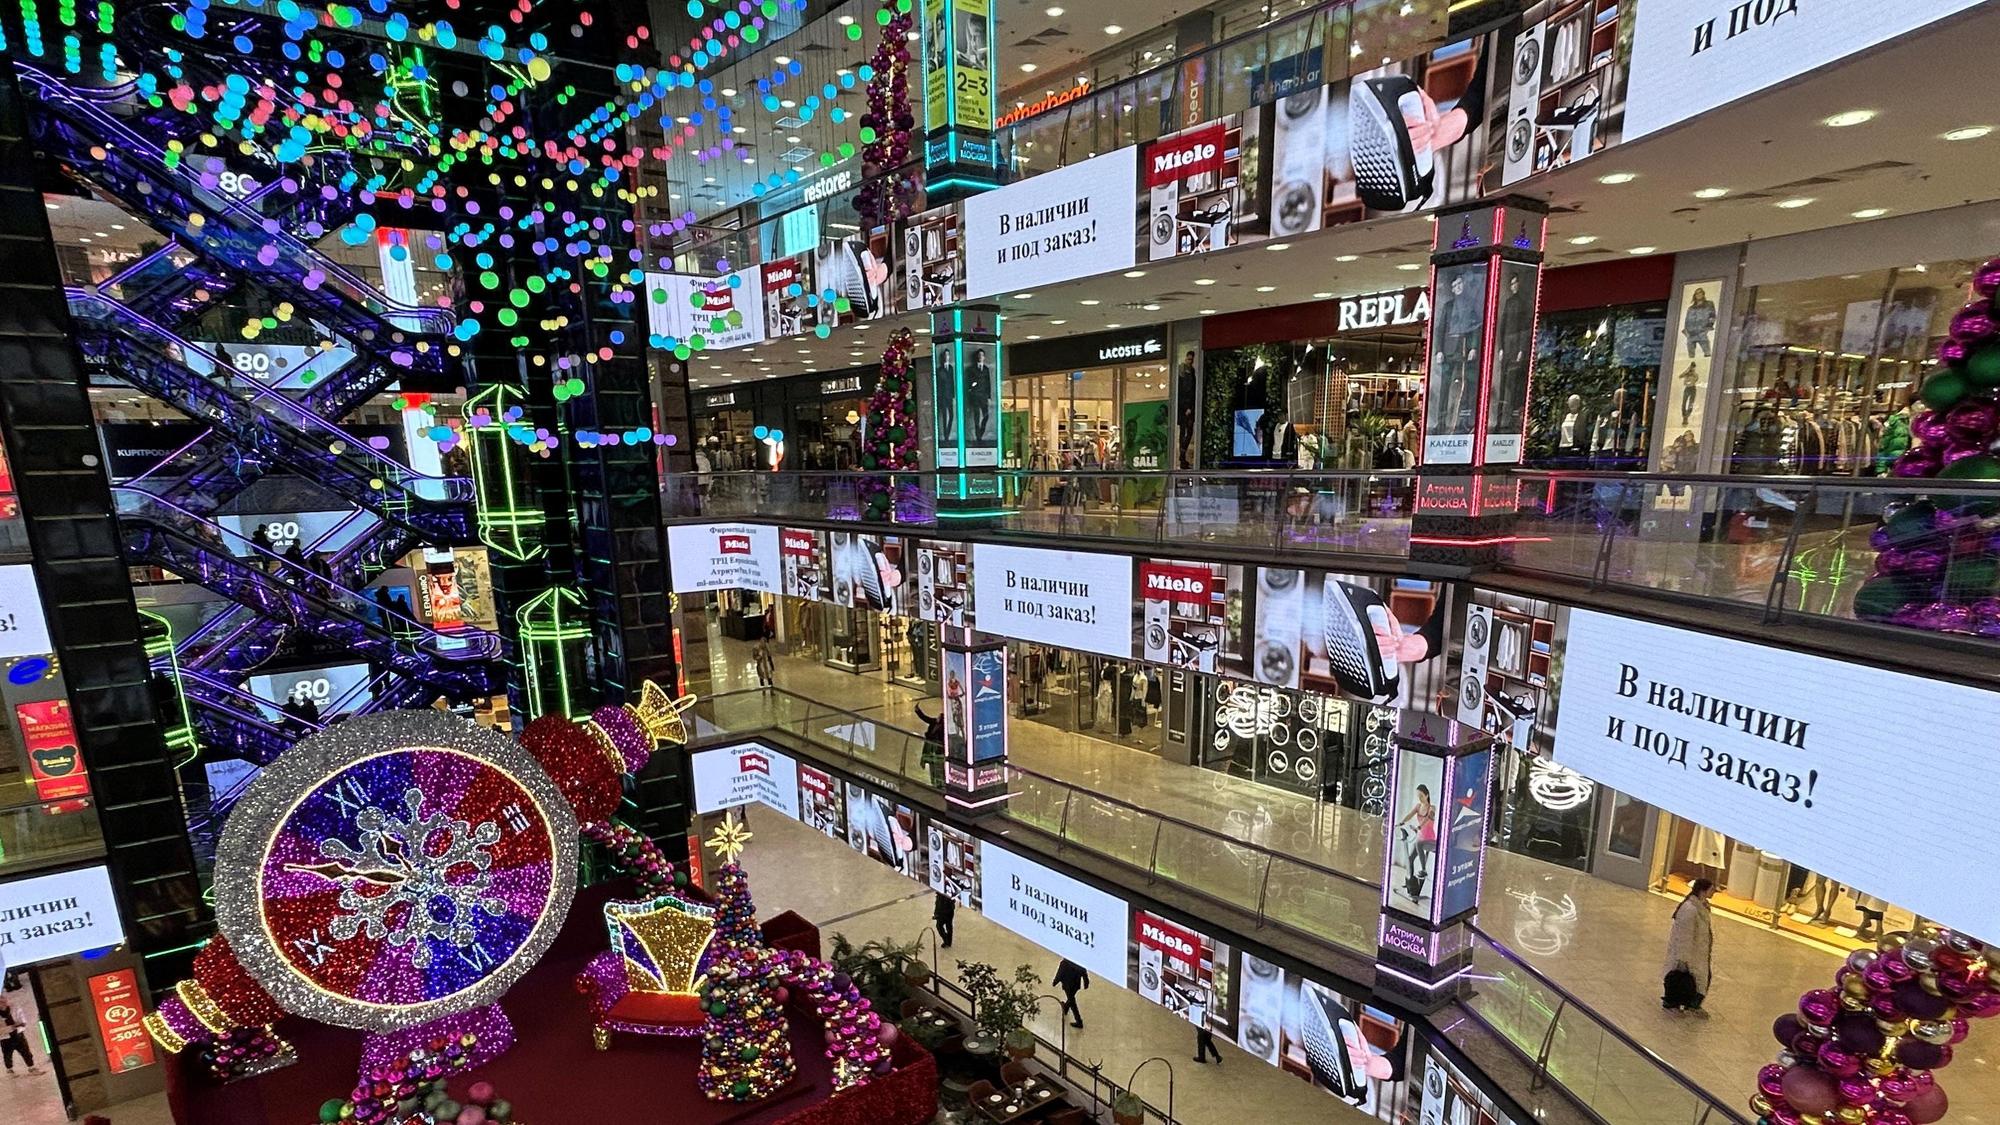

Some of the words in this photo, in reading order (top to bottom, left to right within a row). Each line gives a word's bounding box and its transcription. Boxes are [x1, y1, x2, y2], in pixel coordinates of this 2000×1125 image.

[1690, 16, 1717, 57] и
[1726, 0, 1798, 41] под
[957, 71, 988, 96] 2=3
[1154, 143, 1216, 173] Miele
[804, 171, 851, 204] restore:
[1000, 213, 1011, 236] В
[1014, 196, 1090, 233] наличии
[997, 248, 1007, 265] и
[1011, 238, 1040, 261] под
[1043, 219, 1098, 255] заказ!
[767, 268, 793, 284] Miele
[1099, 344, 1143, 361] LACOSTE
[1429, 439, 1469, 448] KANZLER
[1492, 439, 1515, 447] KANZLER
[1133, 456, 1158, 468] SALE
[1426, 483, 1465, 495] Атриум
[1420, 497, 1468, 509] МОСКВА
[725, 540, 749, 550] Miele
[785, 537, 810, 550] Miele
[1006, 570, 1016, 588] В
[1020, 576, 1089, 597] наличии
[1147, 573, 1204, 593] Miele
[1004, 599, 1013, 611] и
[1017, 599, 1044, 618] под
[1047, 605, 1097, 625] заказ!
[1616, 662, 1640, 699] В
[1647, 679, 1811, 751] наличии
[1605, 714, 1628, 743] и
[1632, 721, 1691, 770] под
[1698, 743, 1820, 809] заказ!
[802, 772, 826, 790] Miele
[1011, 874, 1021, 891] В
[1025, 883, 1089, 924] наличии
[20, 911, 94, 941] заказ!
[1009, 897, 1018, 910] и
[1021, 903, 1046, 927] под
[1049, 916, 1096, 949] заказ!
[1390, 925, 1424, 944] Атриум
[1142, 923, 1194, 955] Miele
[1385, 933, 1427, 957] МОСКВА
